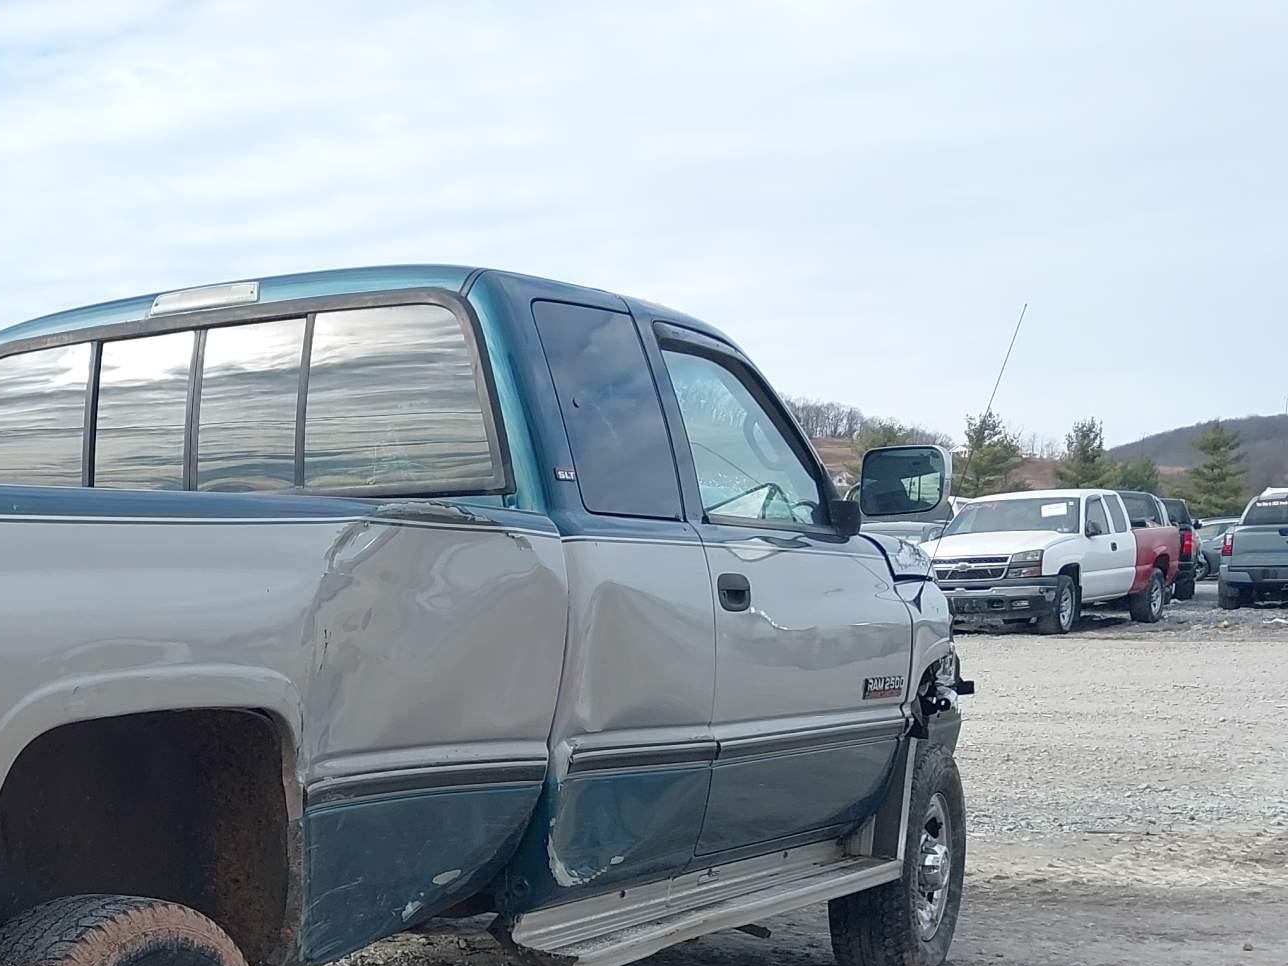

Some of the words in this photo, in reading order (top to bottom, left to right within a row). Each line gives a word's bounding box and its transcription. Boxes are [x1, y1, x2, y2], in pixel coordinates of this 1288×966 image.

[557, 471, 575, 480] SLT
[867, 678, 885, 692] RAM
[884, 676, 905, 690] 2500
